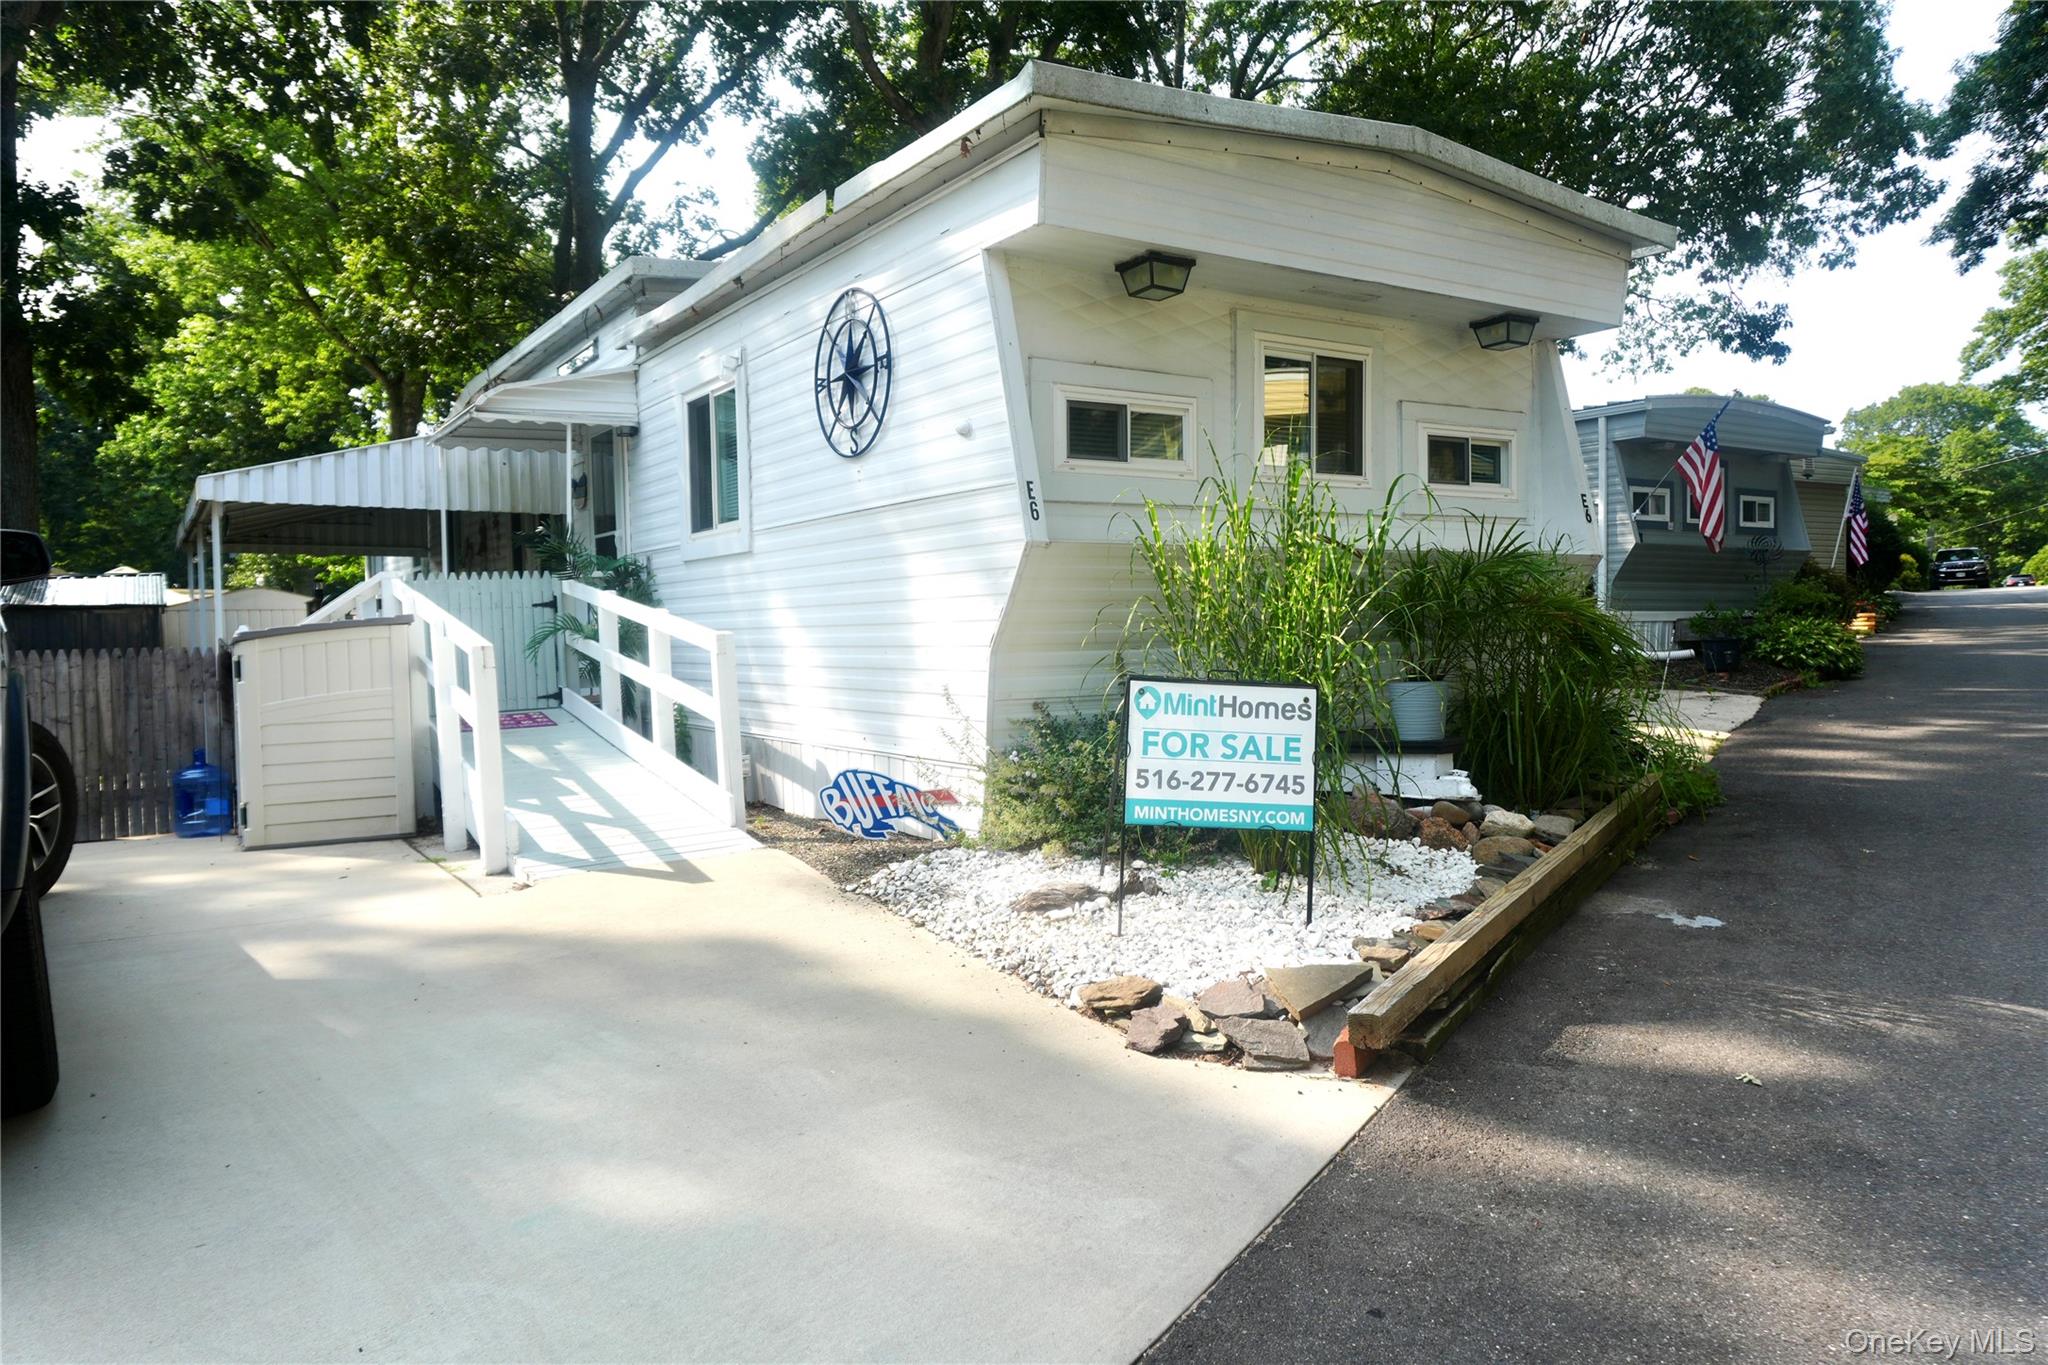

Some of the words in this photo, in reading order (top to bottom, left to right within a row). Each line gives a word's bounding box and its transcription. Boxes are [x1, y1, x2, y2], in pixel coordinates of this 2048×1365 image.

[1164, 691, 1312, 721] MintHomes
[1142, 731, 1210, 758] FOR
[1221, 733, 1302, 762] SALE
[1135, 768, 1305, 795] 516-277-6745
[822, 772, 940, 829] BUFFALO
[1134, 805, 1305, 825] MINTHOMESNY.COM
